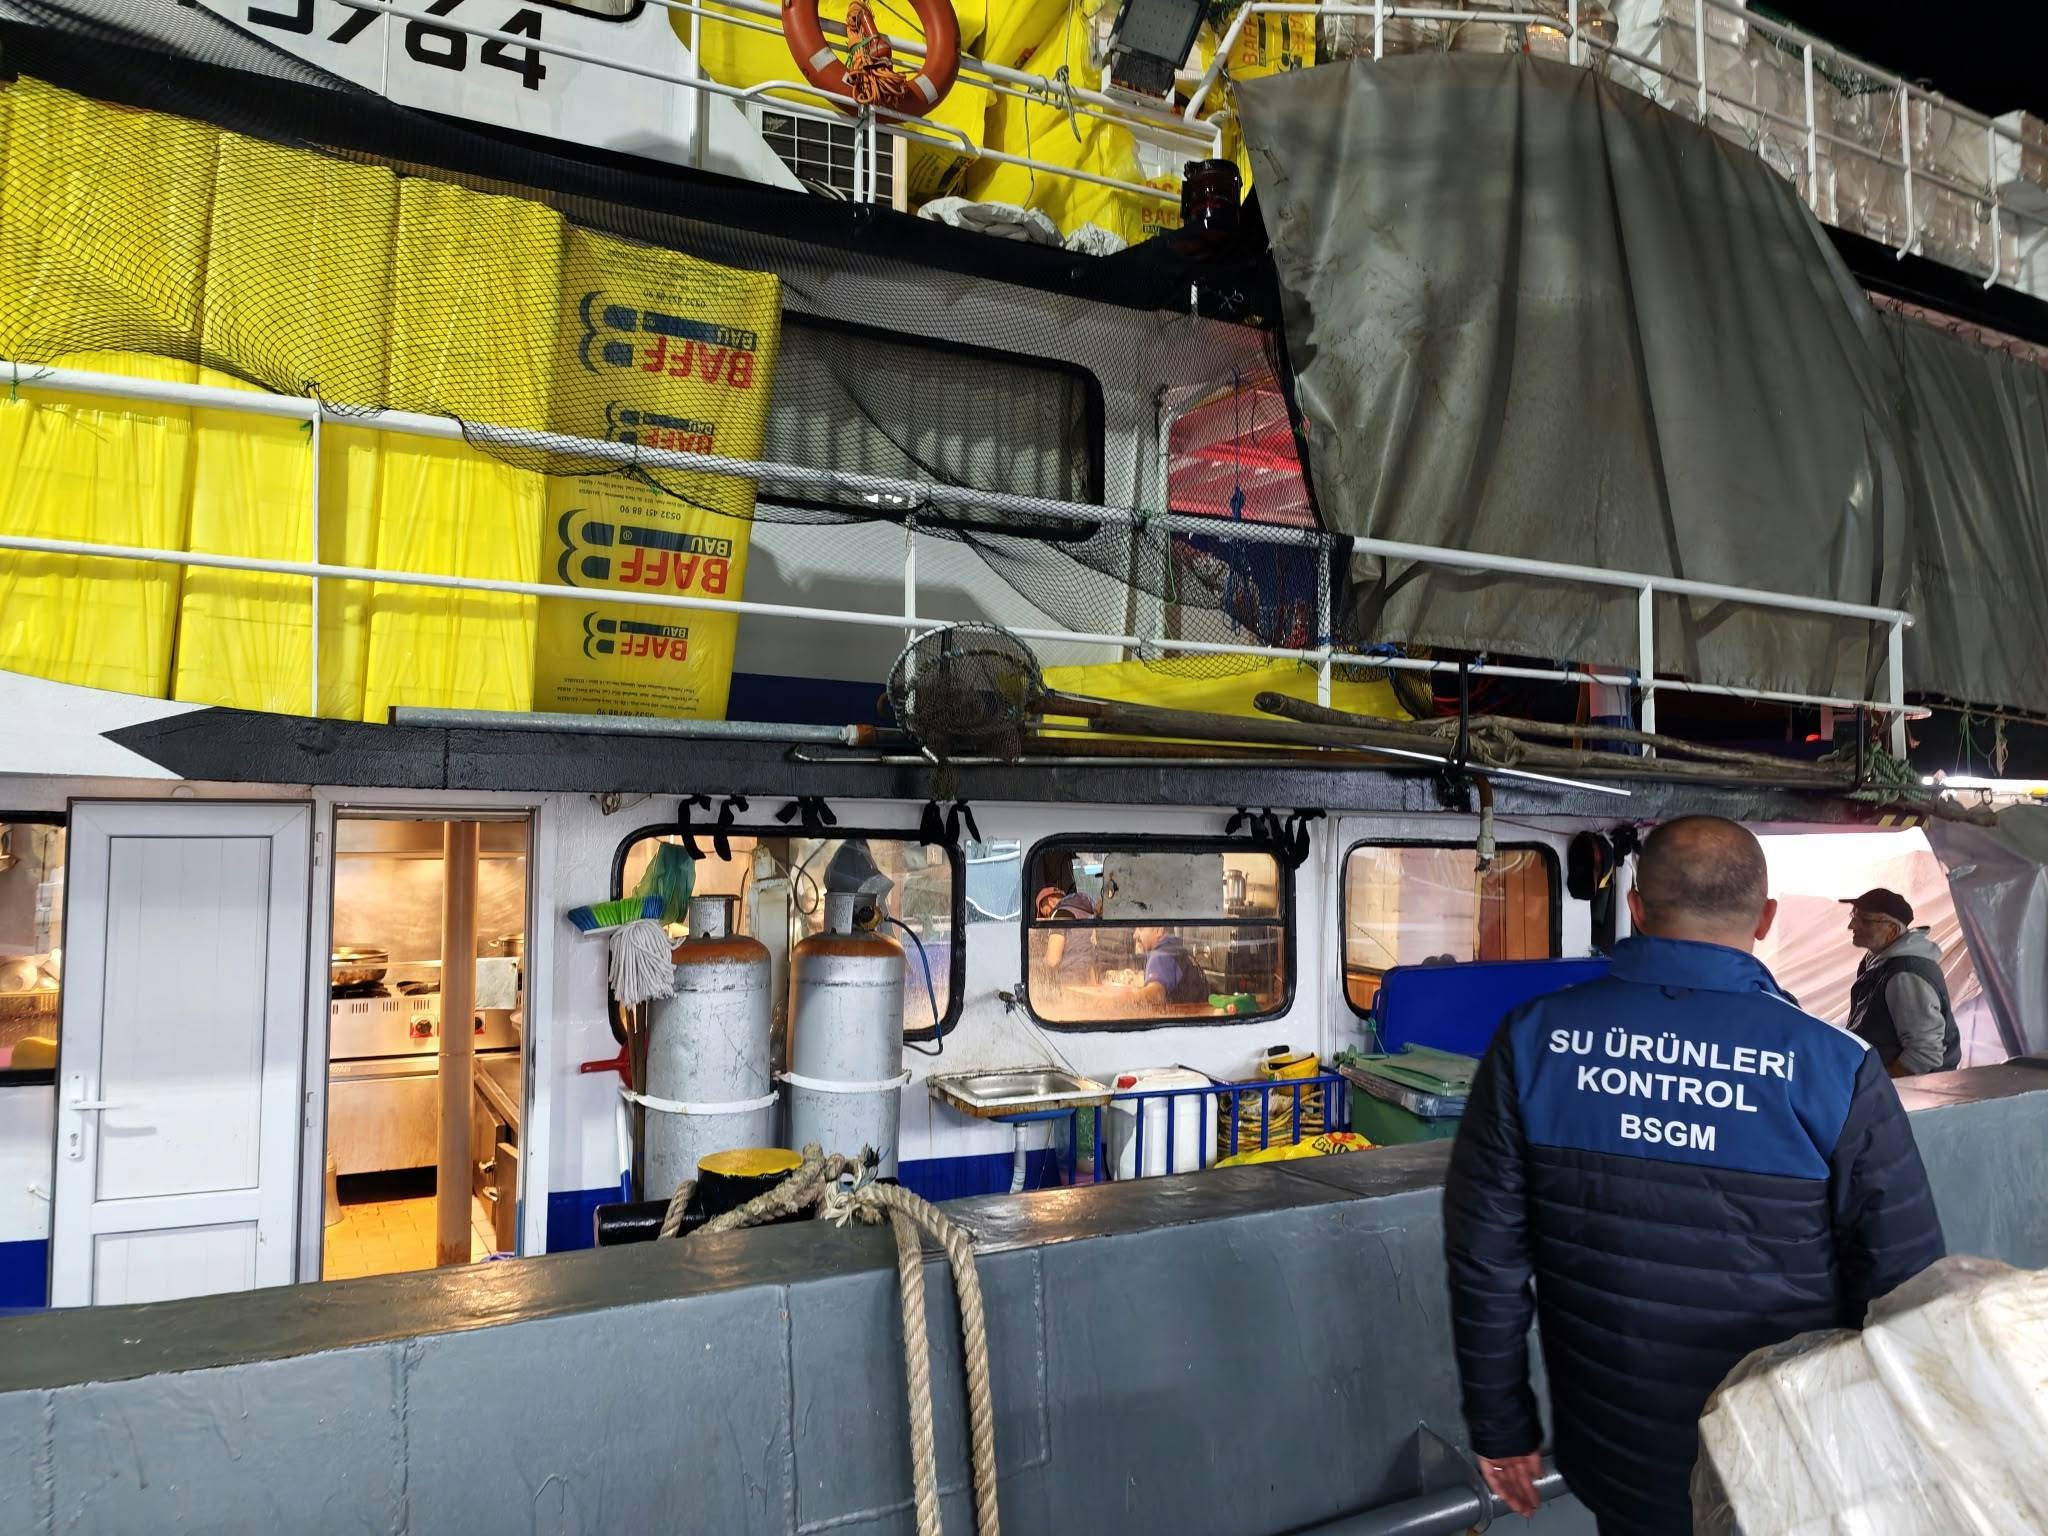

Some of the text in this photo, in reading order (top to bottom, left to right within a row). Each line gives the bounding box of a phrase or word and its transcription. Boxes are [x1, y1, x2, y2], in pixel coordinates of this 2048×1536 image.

[715, 327, 755, 350] BAU
[640, 335, 754, 389] BAFF
[641, 428, 714, 456] BAFF
[619, 504, 681, 521] 0532 451 88 90
[691, 536, 729, 557] BAU
[618, 548, 729, 595] BAFF
[662, 625, 687, 638] BAU
[620, 634, 688, 662] BAFF
[1549, 1027, 1795, 1082] SU ÜRÜNLERİ
[1577, 1065, 1758, 1112] KONTROL
[1620, 1113, 1716, 1152] BSGM
